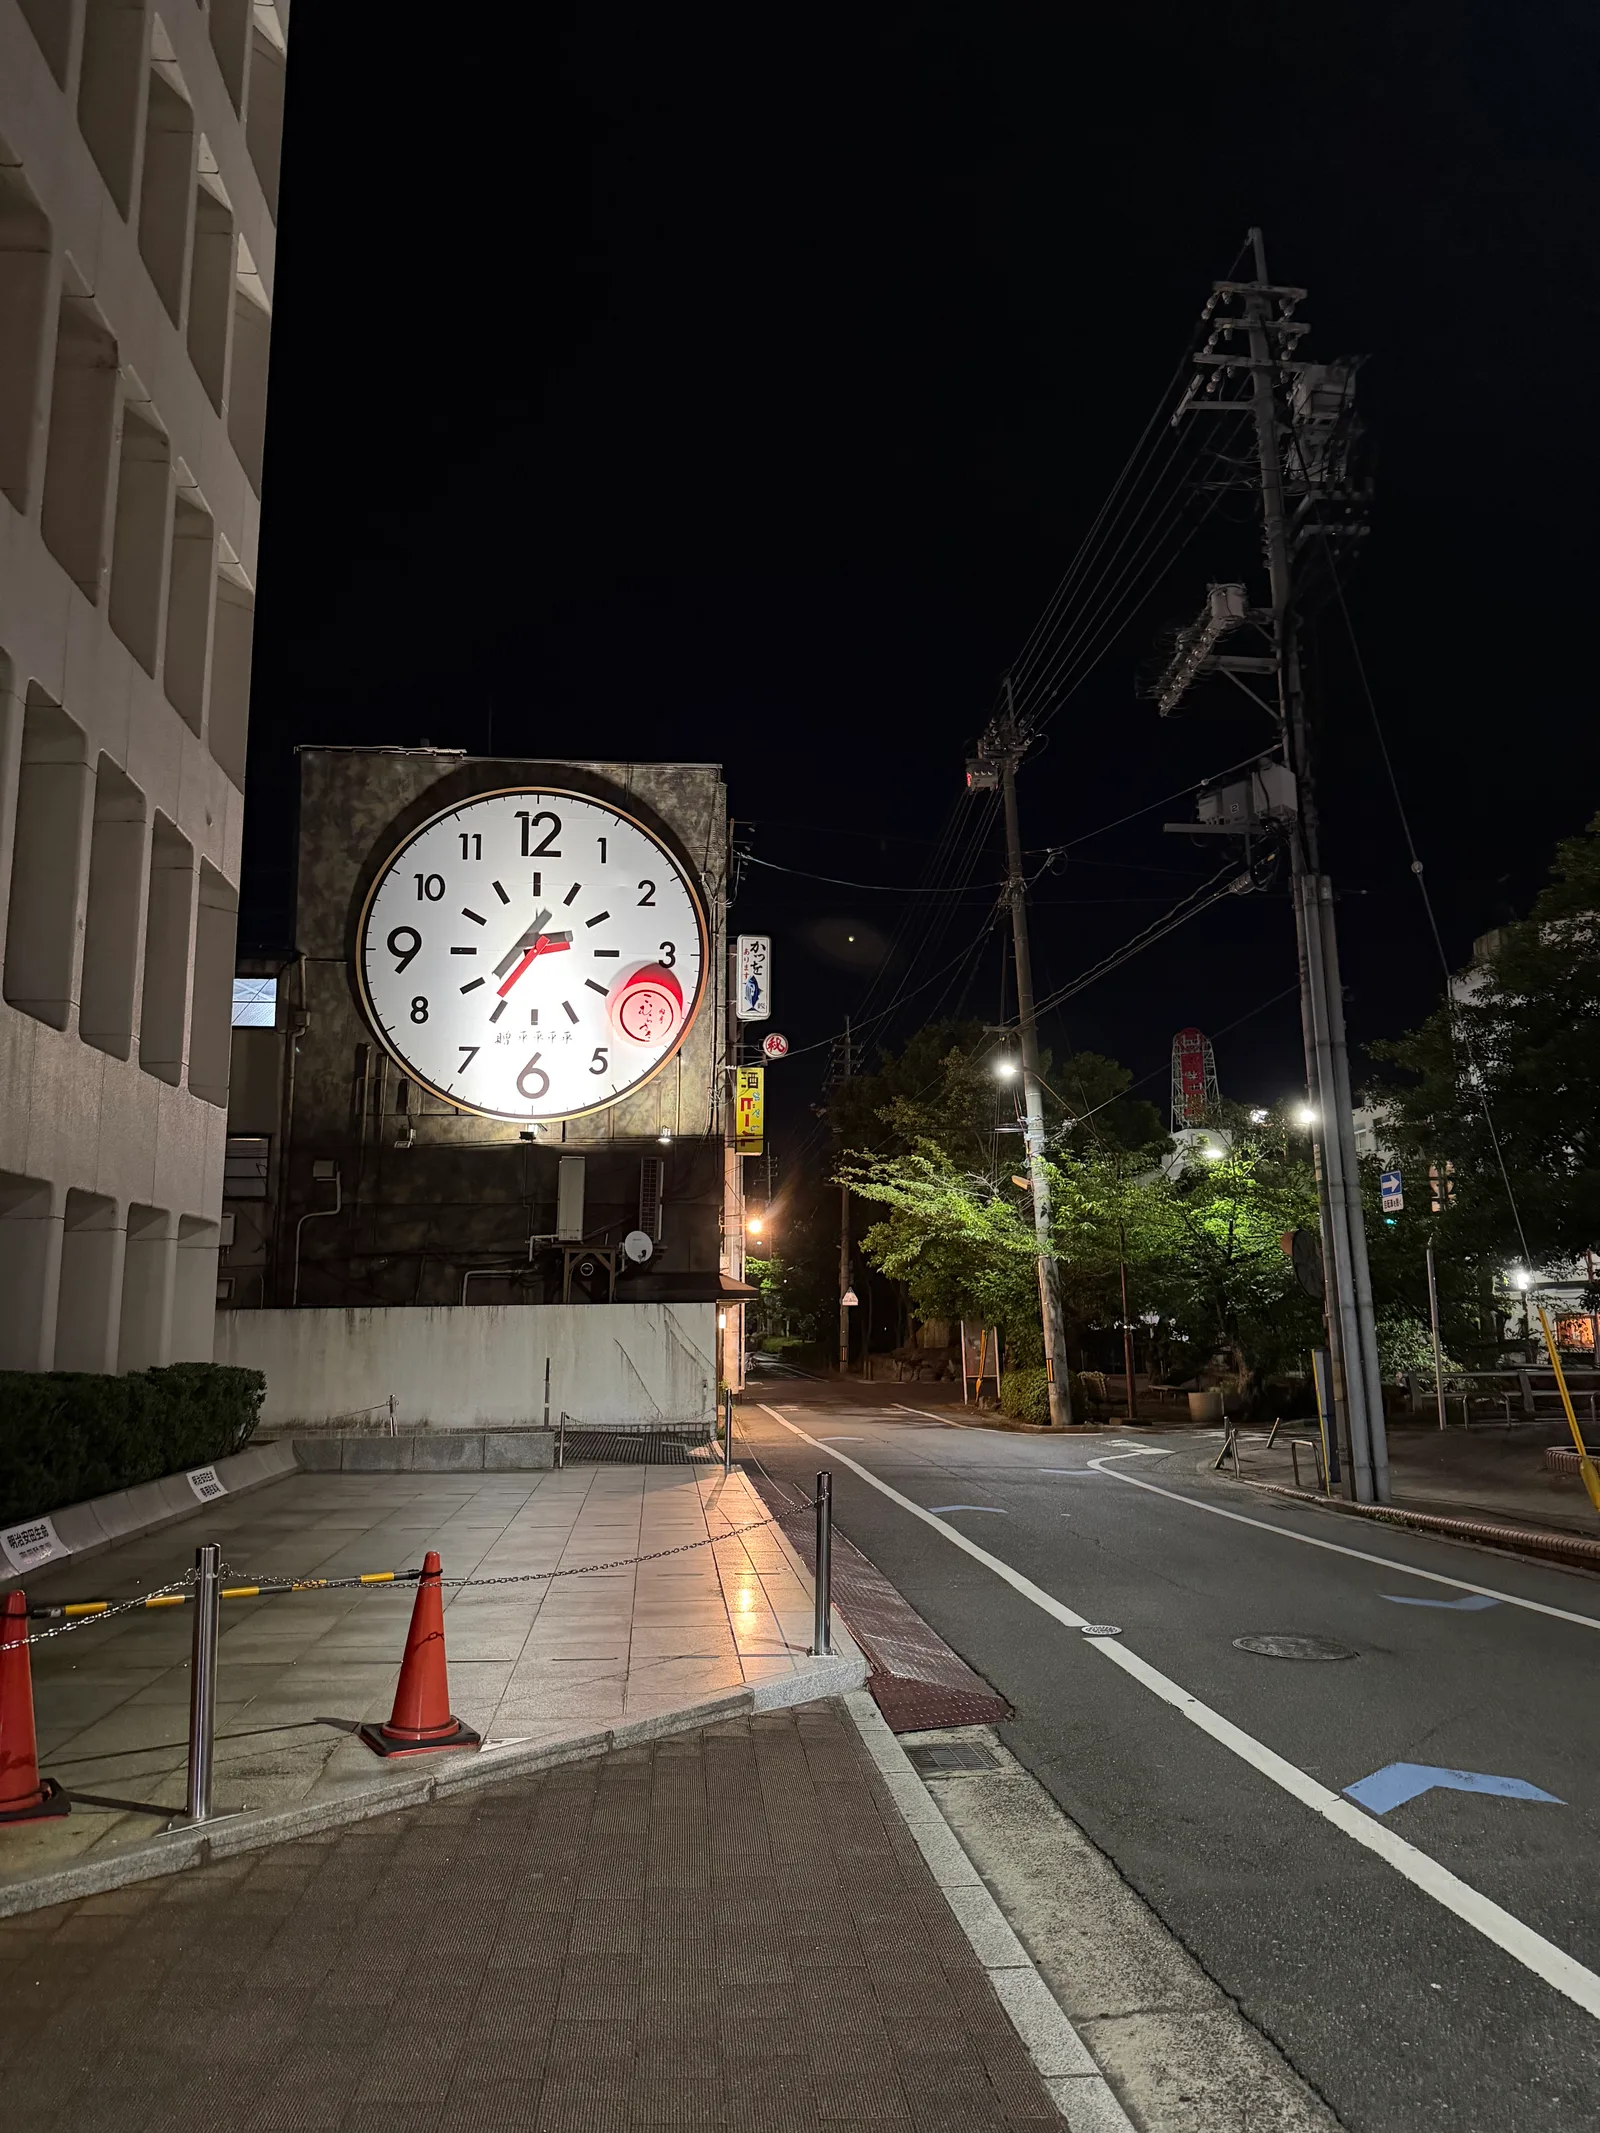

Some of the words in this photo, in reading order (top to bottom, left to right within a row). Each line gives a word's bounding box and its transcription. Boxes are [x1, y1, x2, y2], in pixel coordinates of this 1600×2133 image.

[458, 833, 482, 861] 11
[513, 811, 562, 858] 12
[597, 837, 607, 864] 1
[413, 873, 446, 901] 10
[637, 879, 656, 907] 2
[387, 925, 422, 974] 9
[658, 941, 676, 969] 3
[410, 996, 429, 1024] 8
[458, 1046, 480, 1075] 7
[588, 1047, 608, 1076] 5
[516, 1051, 550, 1100] 6
[740, 1071, 759, 1089] 酒
[6, 1524, 50, 1549] 明治安田生命
